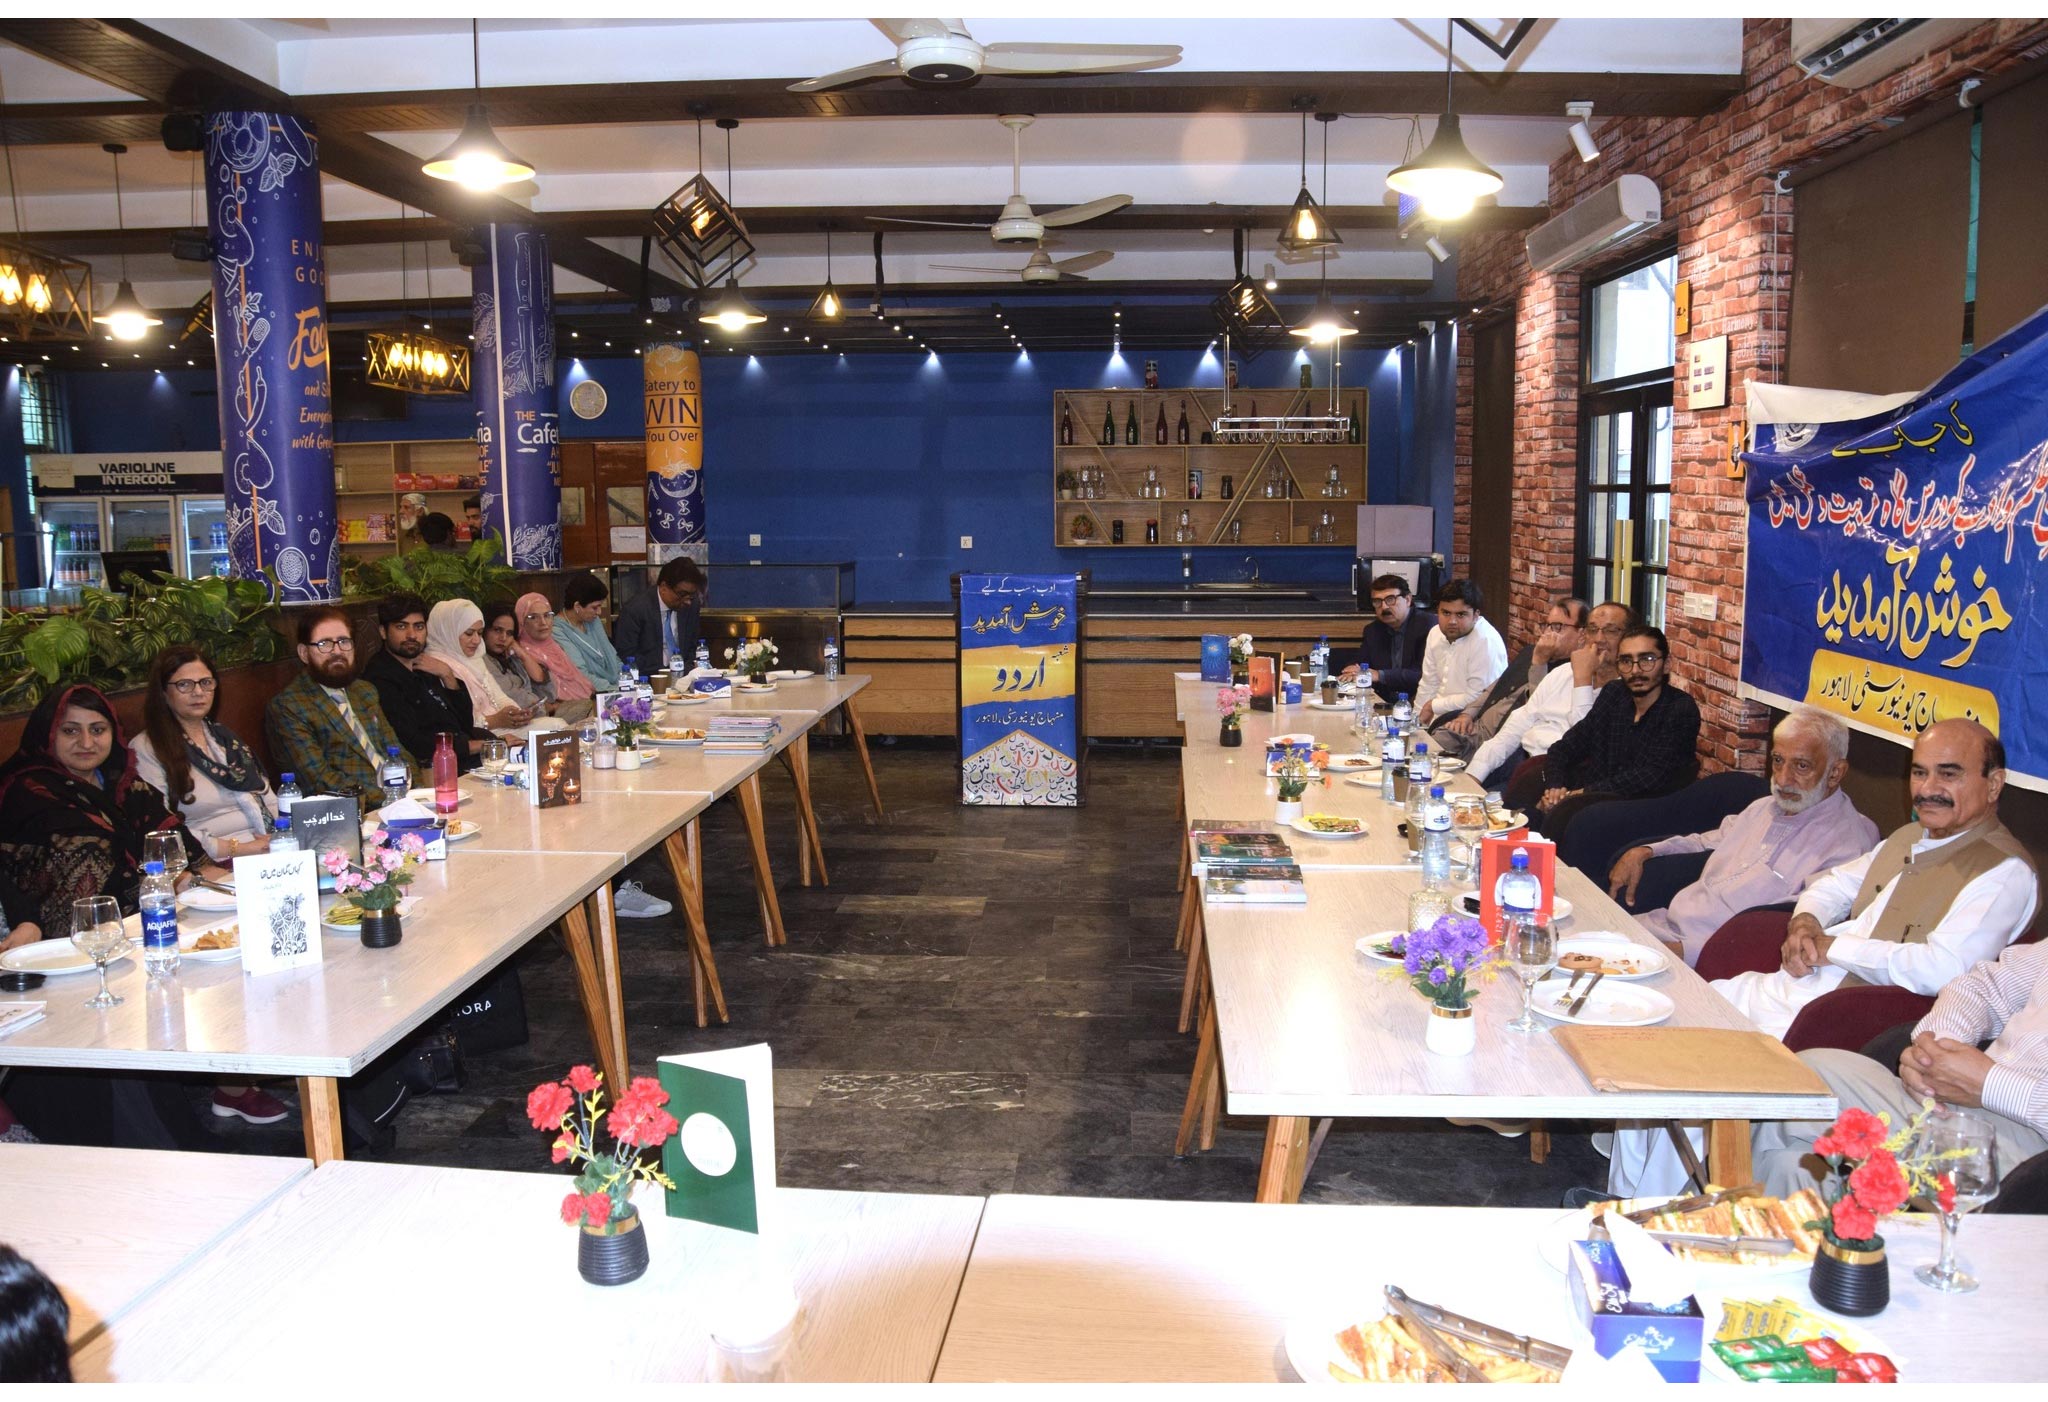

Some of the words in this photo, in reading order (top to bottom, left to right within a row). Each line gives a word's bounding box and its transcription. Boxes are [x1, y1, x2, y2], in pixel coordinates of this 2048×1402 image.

[305, 380, 320, 396] and
[684, 380, 695, 391] to
[515, 410, 536, 421] THE
[292, 432, 315, 449] with
[647, 431, 665, 442] You
[669, 430, 698, 442] Over
[99, 462, 176, 474] VARIOLINE
[102, 474, 176, 485] INTERCOOL
[1816, 542, 1921, 652] آمدید
[1009, 600, 1067, 634] خوش
[1900, 552, 2012, 668] خوش
[970, 604, 1014, 635] آمدید
[991, 656, 1045, 692] اردو
[1820, 671, 1853, 702] لاہور
[1037, 711, 1064, 726] منہاج
